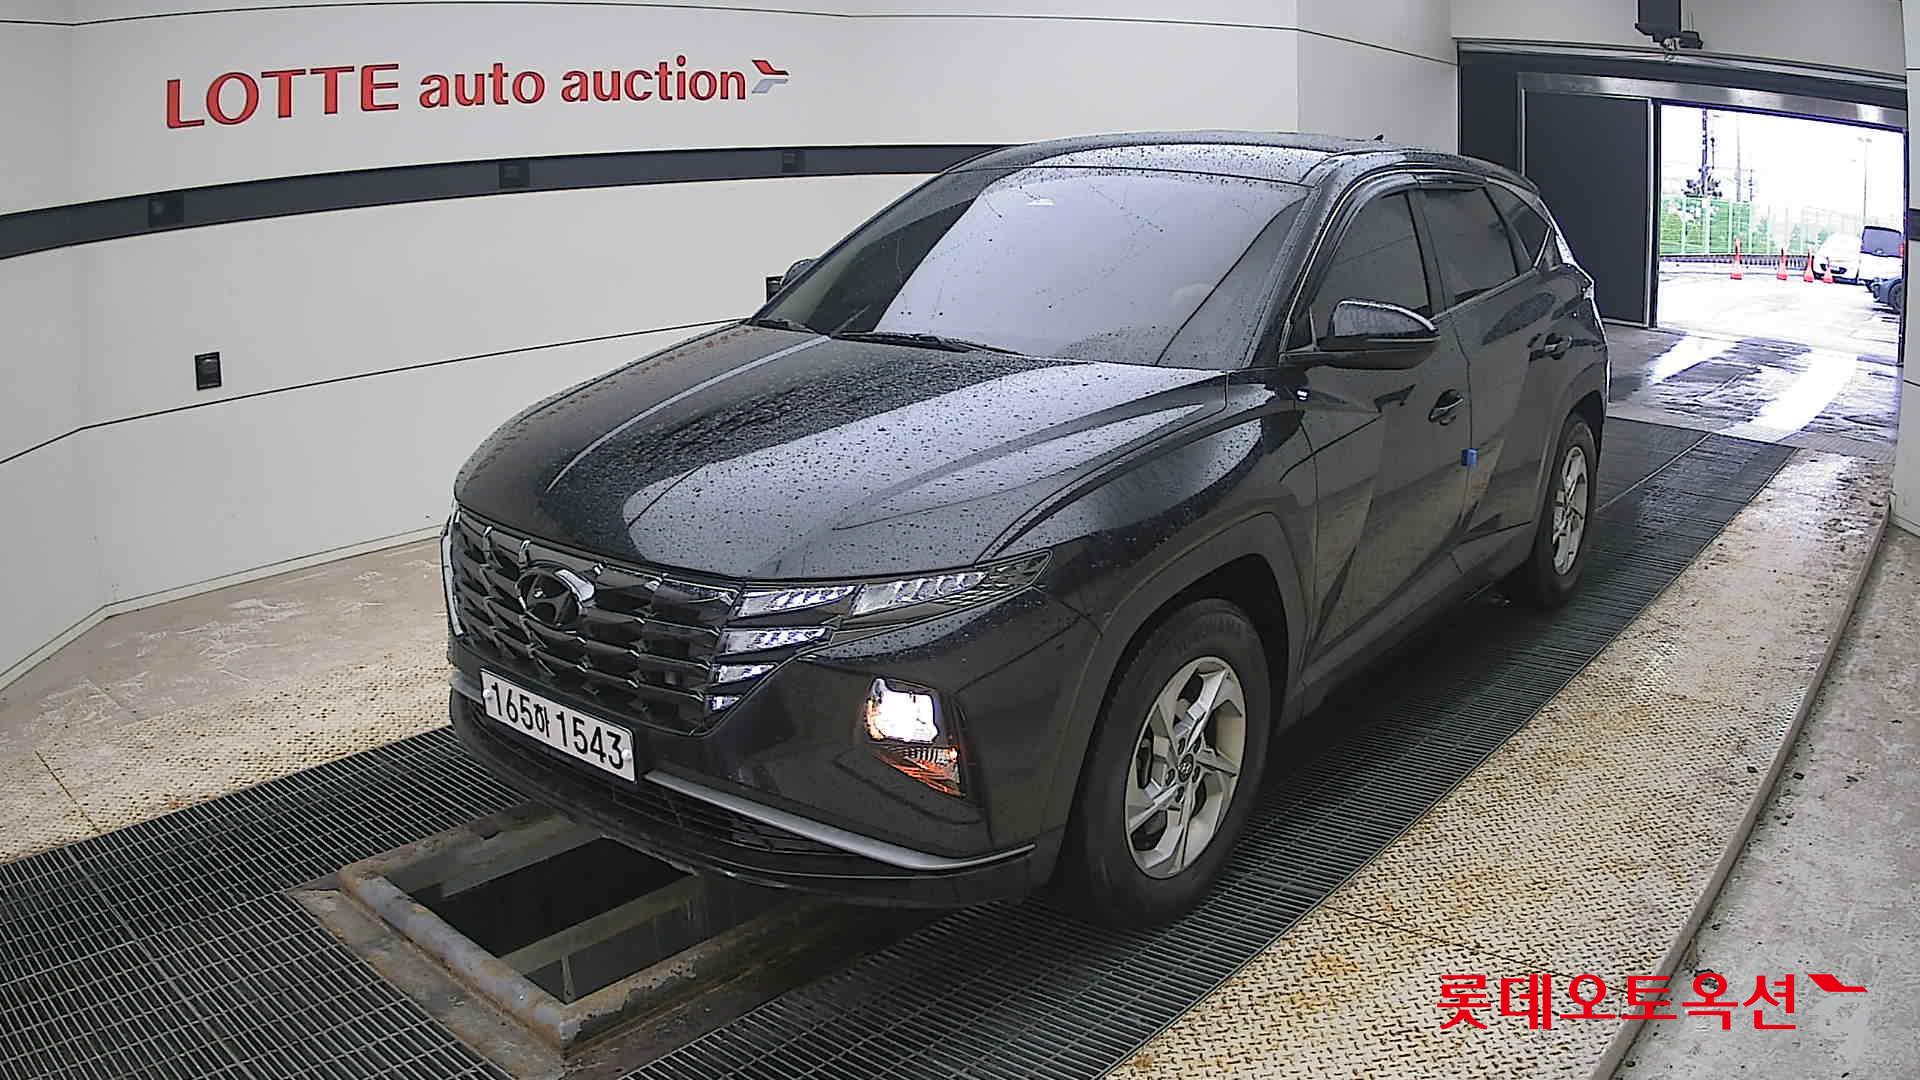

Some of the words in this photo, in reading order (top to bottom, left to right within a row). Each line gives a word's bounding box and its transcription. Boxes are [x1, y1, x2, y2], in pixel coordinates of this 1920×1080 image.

[166, 63, 400, 129] LOTTE
[419, 62, 546, 108] auto
[561, 55, 747, 102] auction
[491, 682, 550, 738] 165하
[556, 711, 624, 770] 1543
